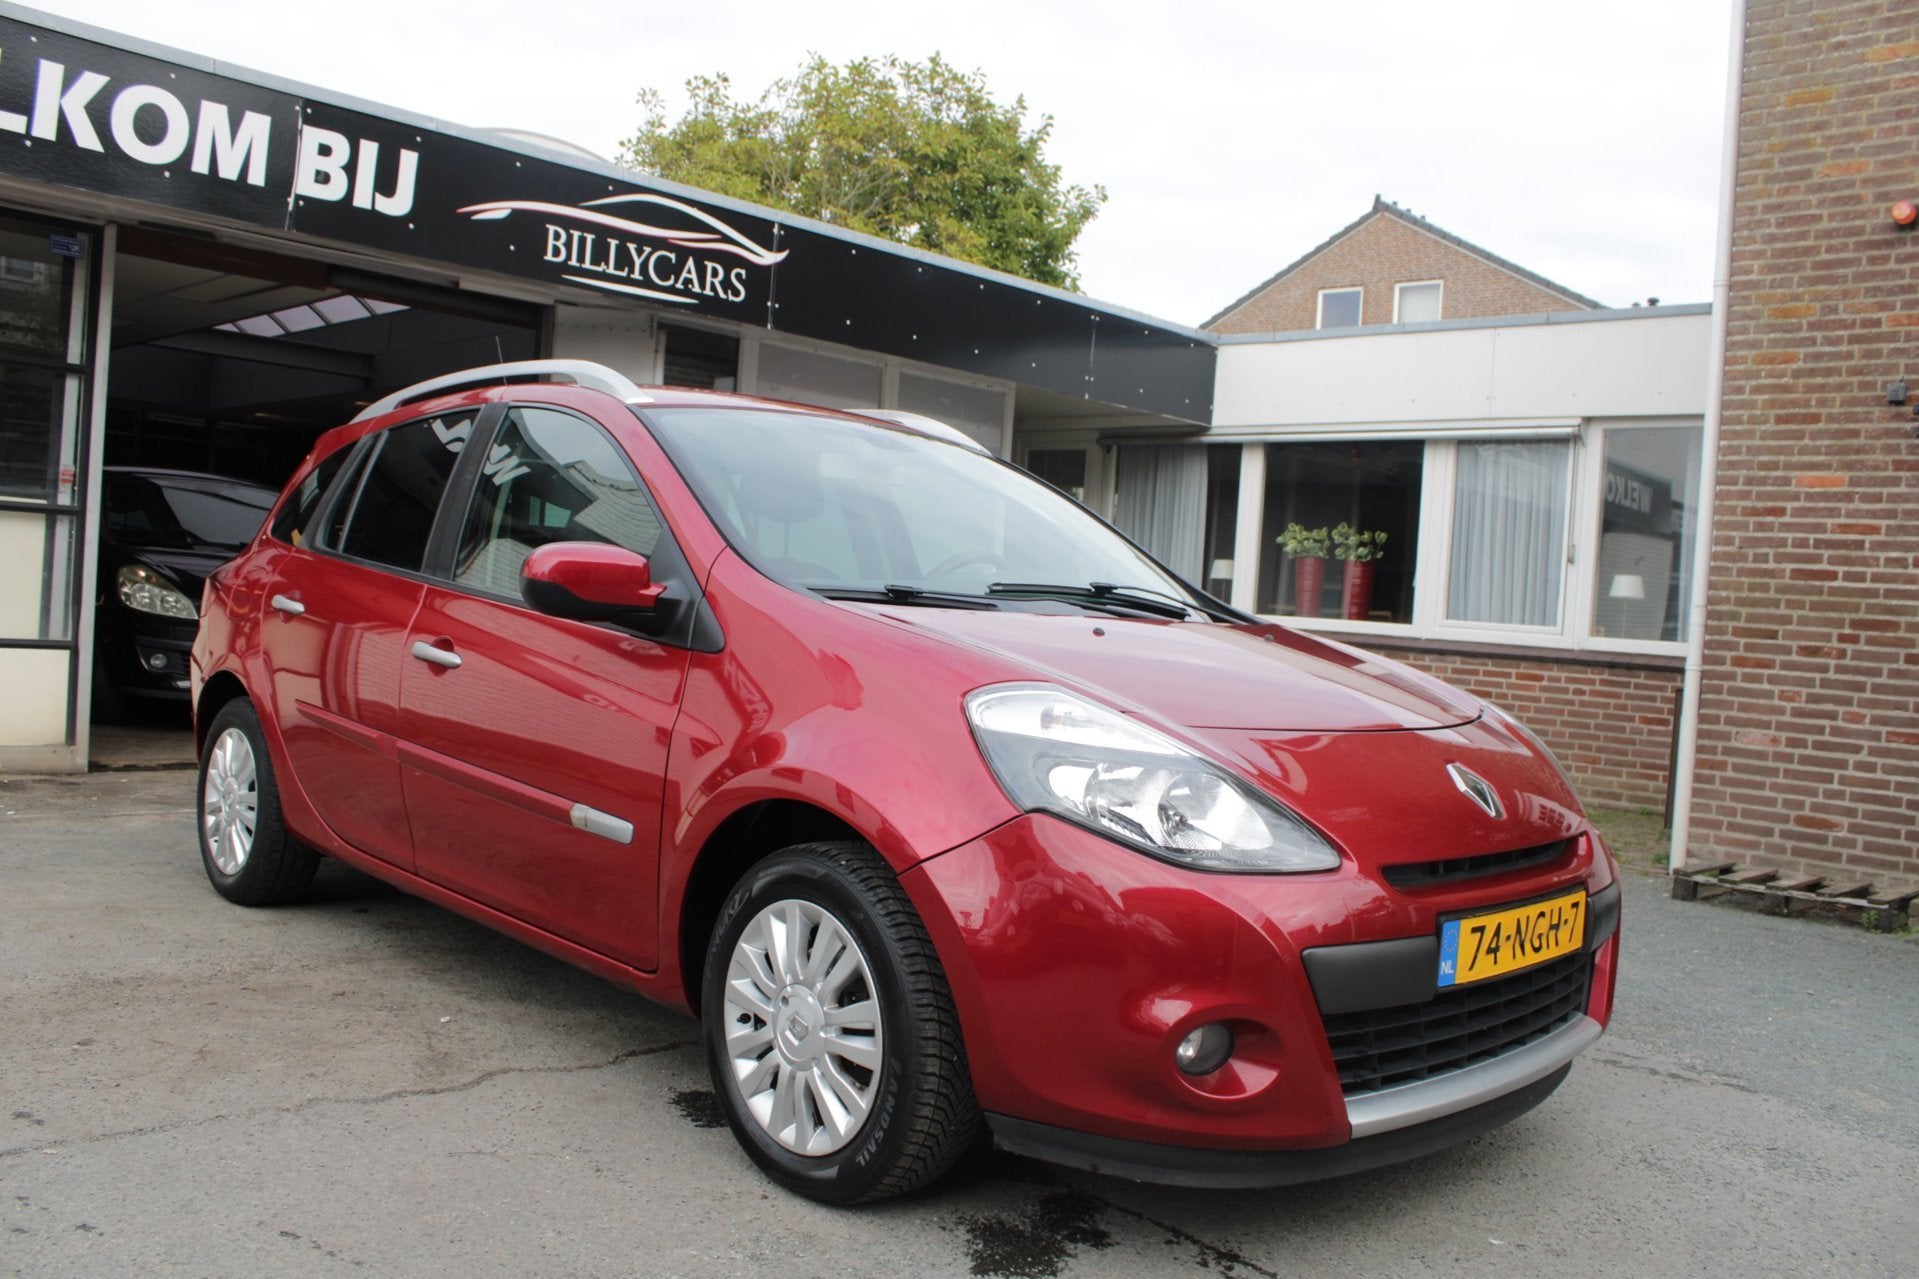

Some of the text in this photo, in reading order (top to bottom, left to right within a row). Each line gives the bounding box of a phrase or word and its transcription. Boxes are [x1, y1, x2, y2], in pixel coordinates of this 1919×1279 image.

[295, 124, 420, 217] BIJ
[543, 223, 747, 302] BILLYCARS
[1440, 959, 1455, 974] NL
[1468, 901, 1580, 971] 74-NGH-7
